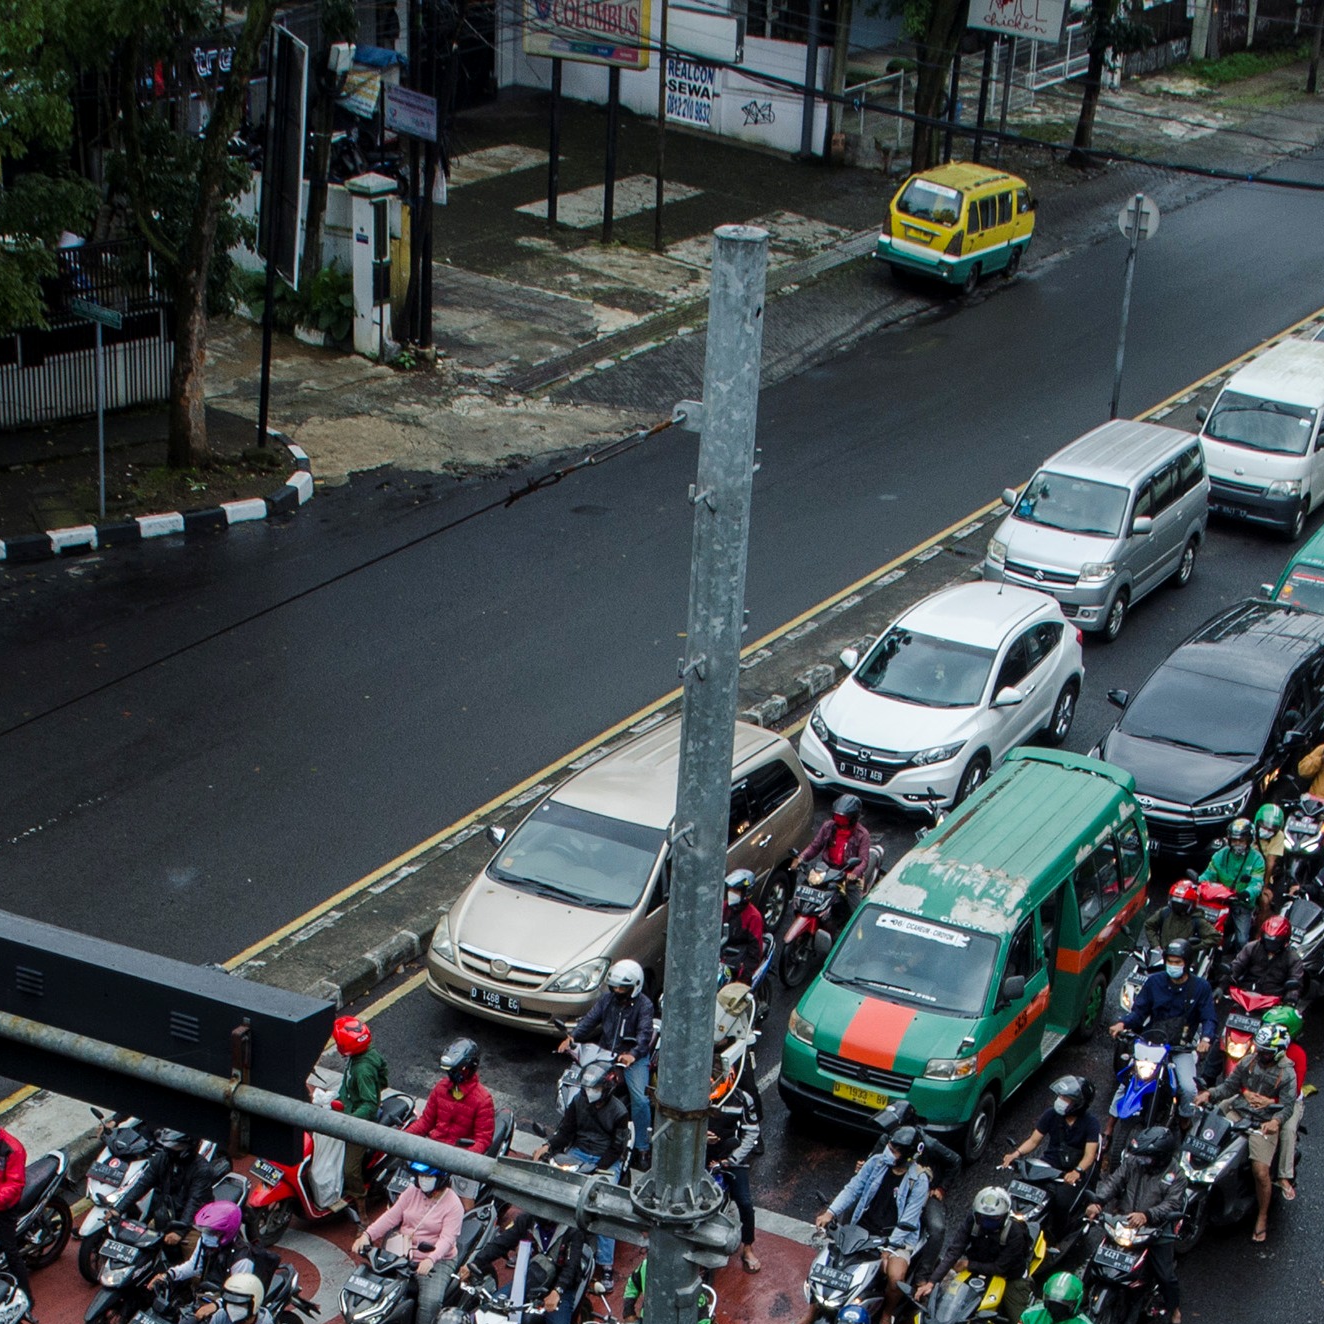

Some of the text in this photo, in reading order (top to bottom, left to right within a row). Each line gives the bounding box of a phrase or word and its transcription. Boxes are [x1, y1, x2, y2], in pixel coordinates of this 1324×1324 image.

[553, 0, 638, 36] COLUMBUS
[983, 12, 1047, 34] chicken
[668, 60, 715, 85] REALCON
[667, 79, 710, 100] SEWA
[852, 764, 867, 777] 1751
[470, 988, 476, 998] D
[482, 990, 500, 1004] 1468
[507, 998, 518, 1009] EG
[835, 1083, 841, 1092] D
[849, 1085, 868, 1100] 1933
[876, 1095, 887, 1105] BV
